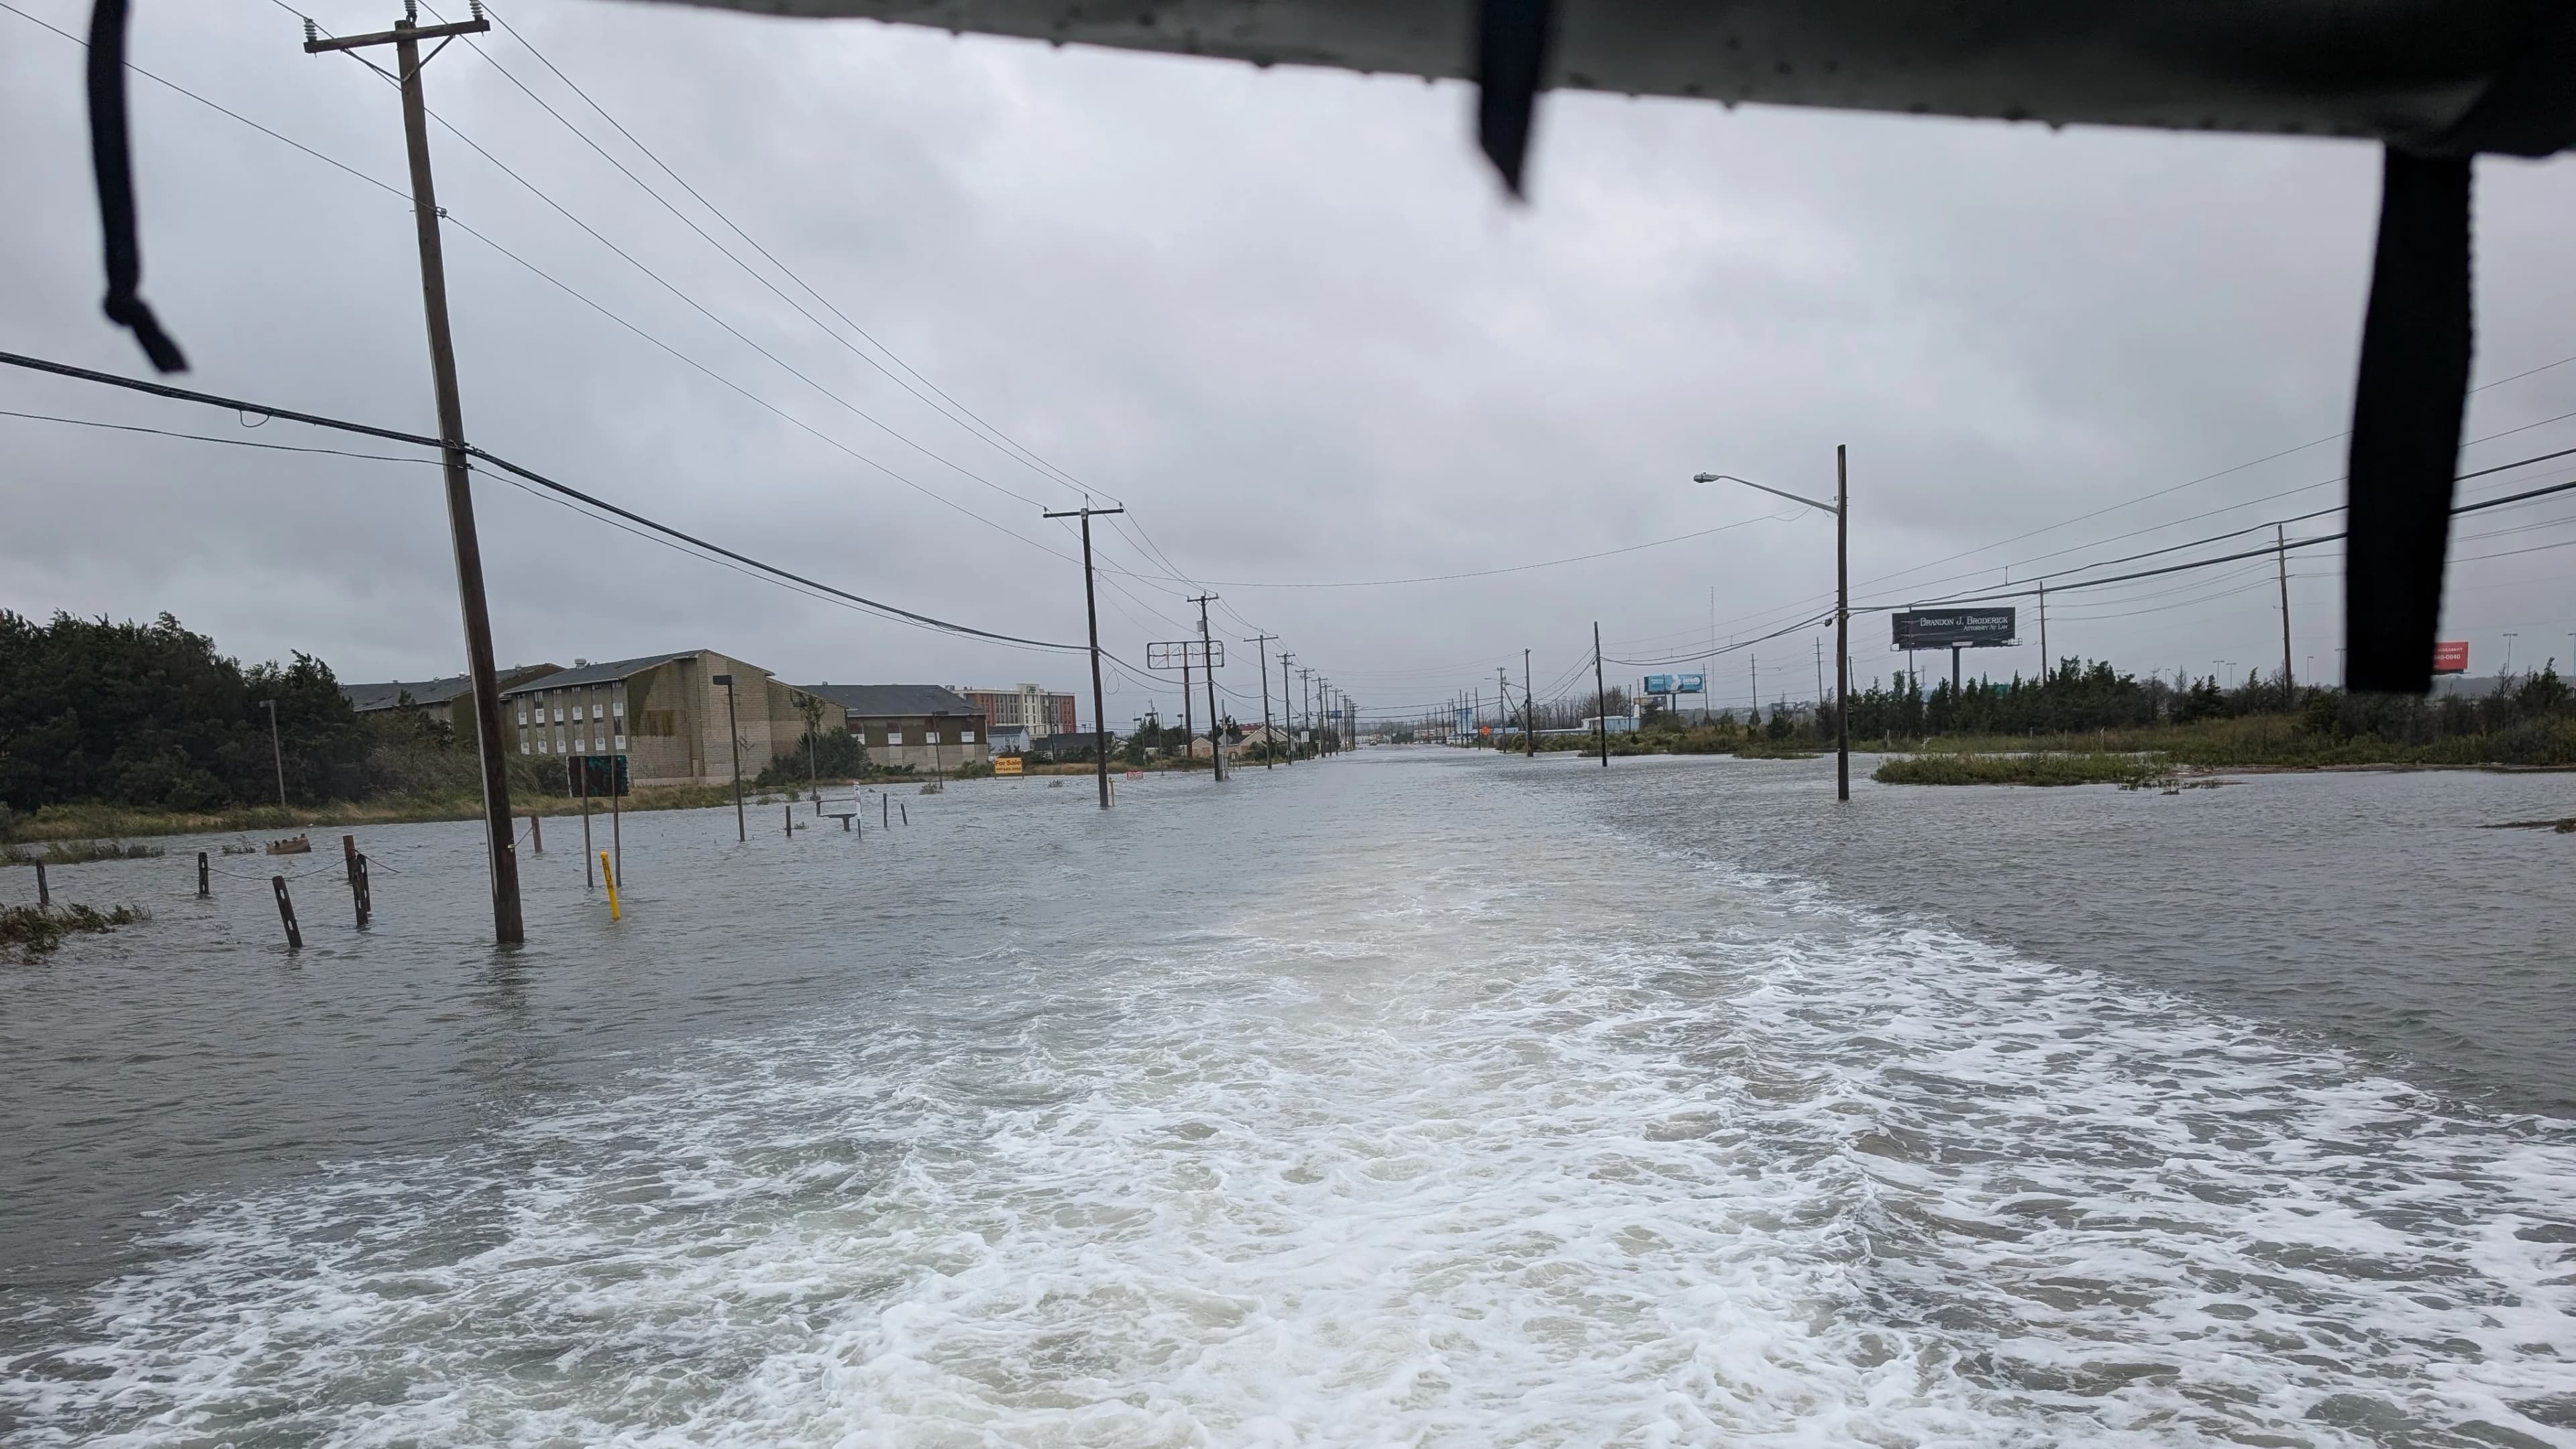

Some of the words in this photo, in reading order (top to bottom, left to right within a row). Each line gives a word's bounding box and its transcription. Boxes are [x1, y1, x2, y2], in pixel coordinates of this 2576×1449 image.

[1920, 617, 1953, 627] BRANDON
[1956, 616, 1964, 625] J.
[1967, 616, 2008, 625] BRODERICK
